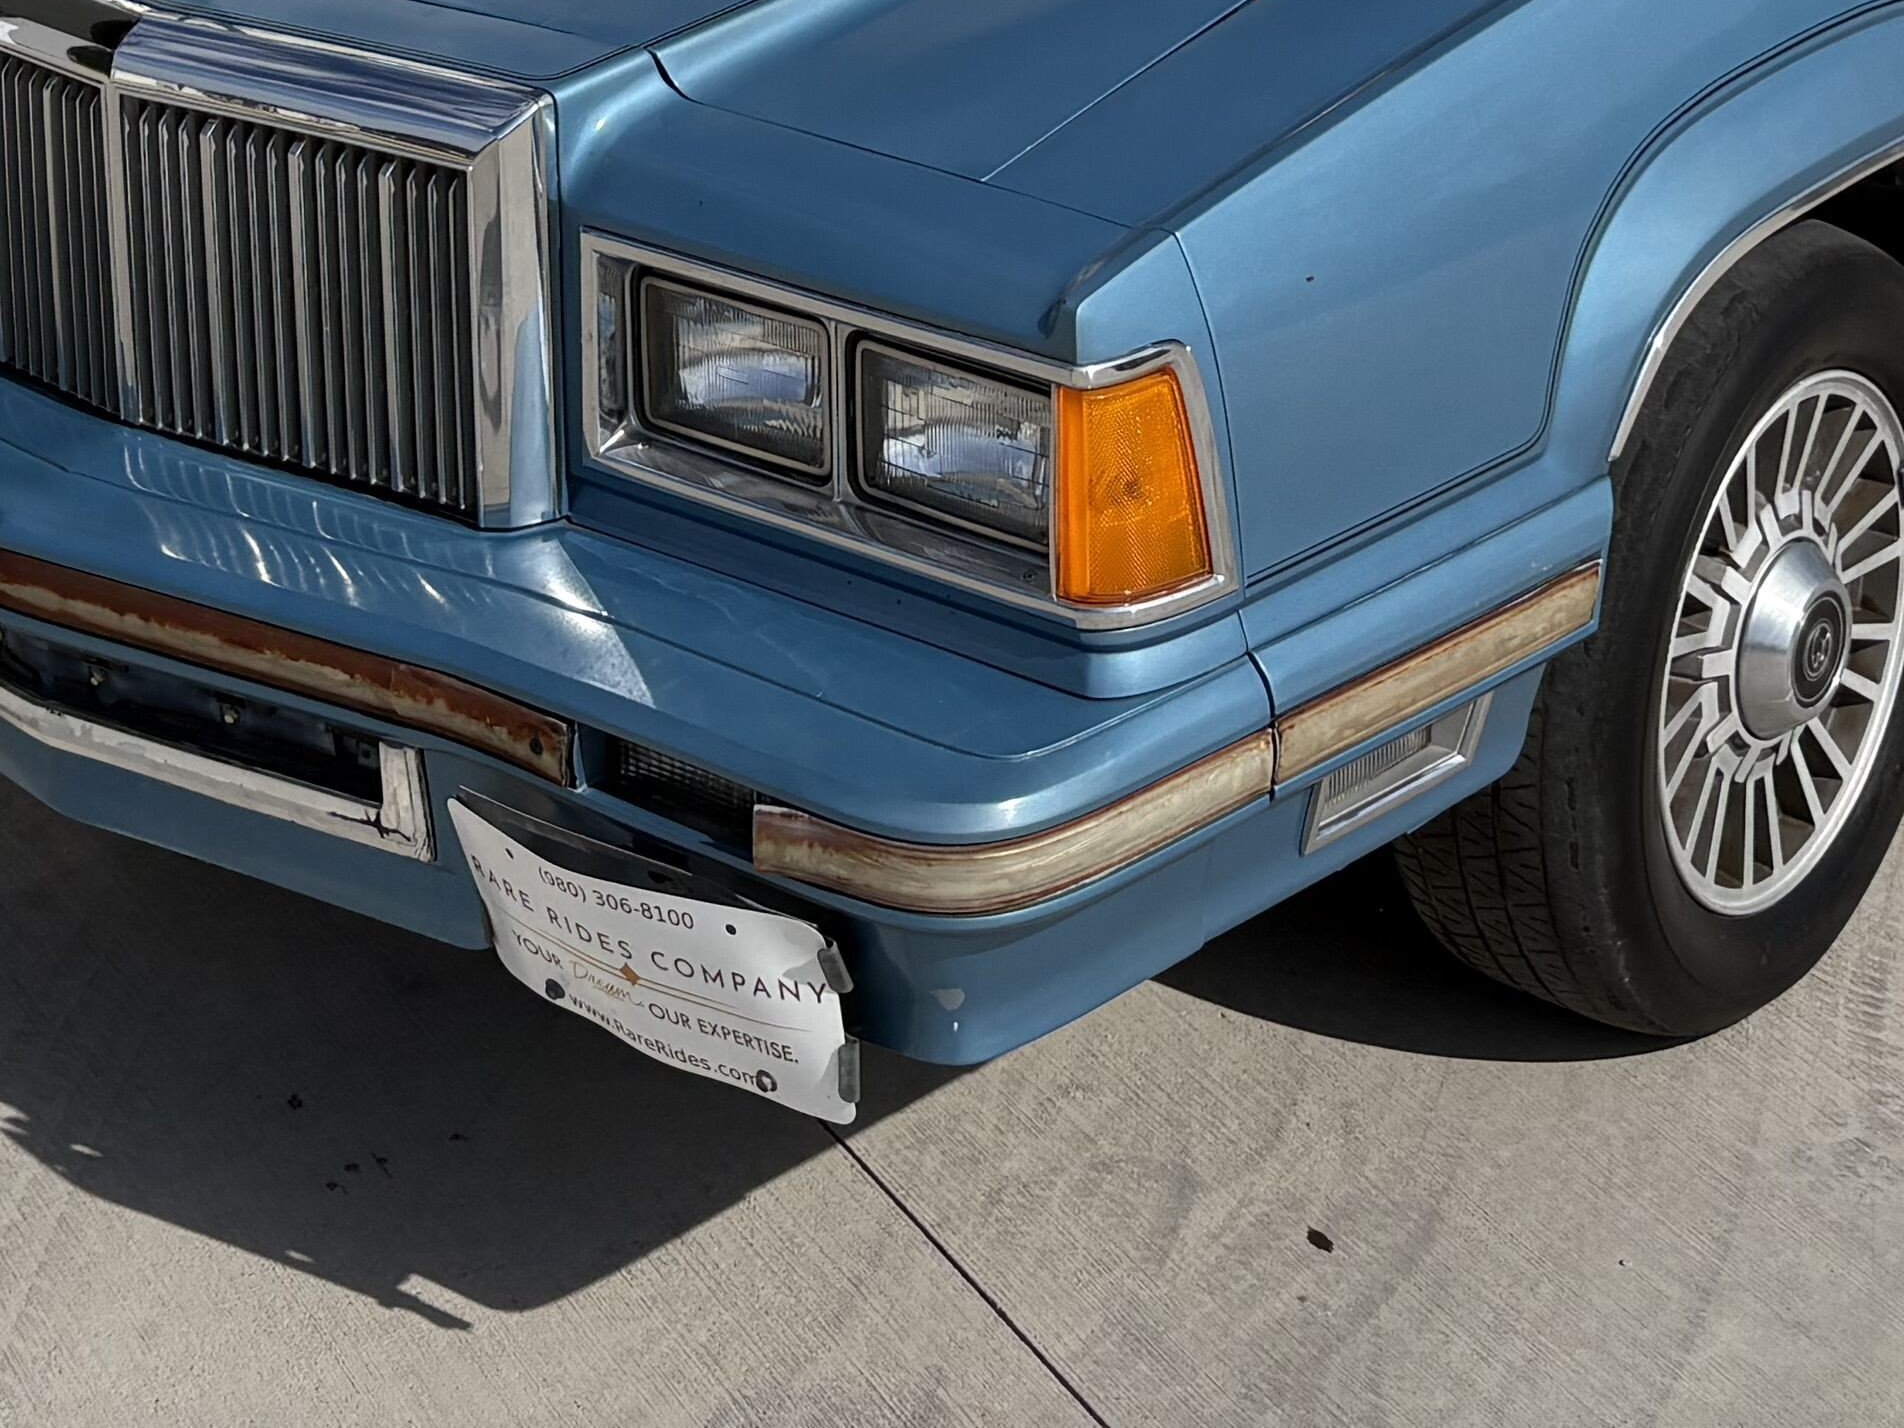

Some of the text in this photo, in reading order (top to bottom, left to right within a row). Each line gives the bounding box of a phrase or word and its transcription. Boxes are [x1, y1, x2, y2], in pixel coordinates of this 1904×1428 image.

[470, 853, 829, 1004] RARE RIDES COMPANY
[592, 888, 696, 930] 306-8100
[511, 929, 565, 971] YOUR
[648, 1002, 693, 1031] OUR
[697, 1017, 800, 1065] EXPERTISE.
